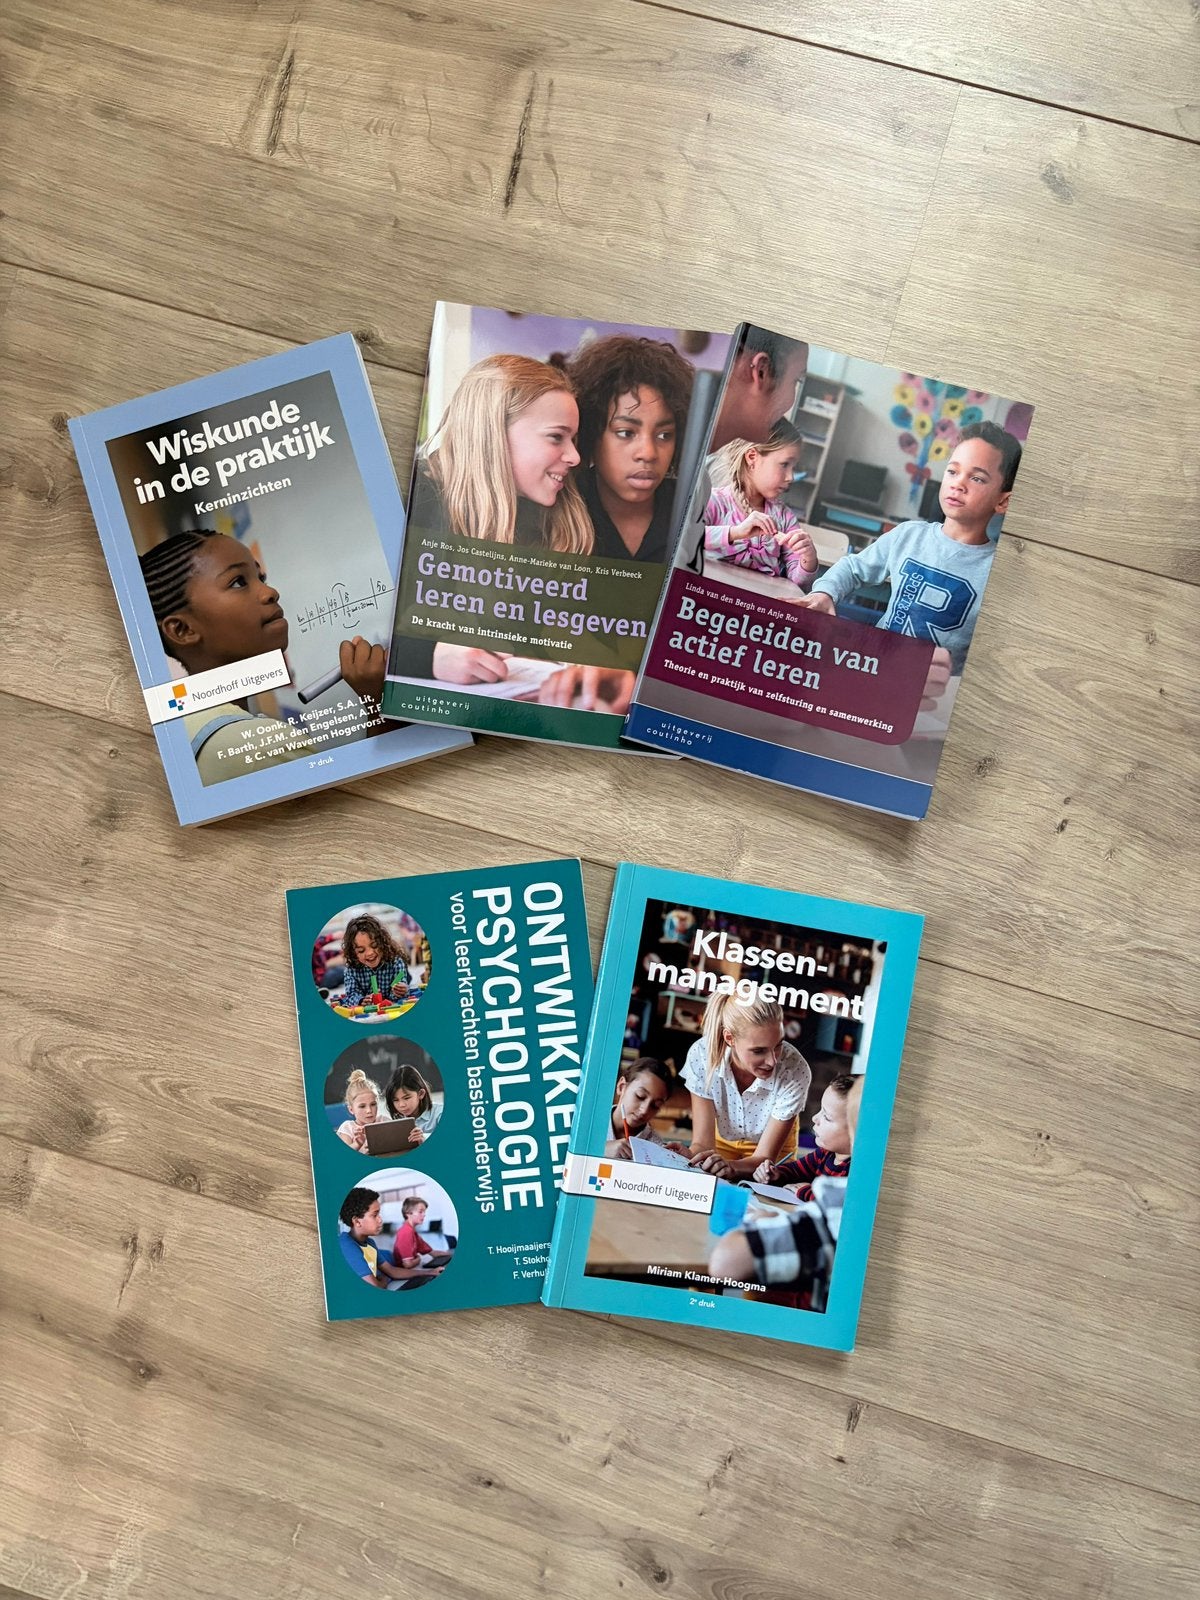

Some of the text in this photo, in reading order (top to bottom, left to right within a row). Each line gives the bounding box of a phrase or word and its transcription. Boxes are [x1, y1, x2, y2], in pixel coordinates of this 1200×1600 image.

[146, 400, 301, 465] Wiskunde
[134, 420, 335, 504] in de praktijk
[194, 477, 292, 515] Kerninzichten
[418, 552, 588, 601] Gemotiveerd
[421, 538, 642, 579] Anje Ros, Jos Castelijns, Anne-Marieke van Loon, Kris Verbeeck
[415, 580, 485, 615] leren
[493, 601, 525, 622] en
[533, 601, 647, 638] lesgeven
[685, 582, 799, 623] Linda van den Bergh en Anje Ros
[411, 616, 573, 650] De kracht van intrinsieke motivatie
[677, 596, 879, 675] Begeleiden van
[668, 630, 821, 690] actief leren
[192, 668, 284, 702] Noordhoff Uitgevers
[415, 696, 470, 710] uitgeverij
[664, 659, 894, 733] Theorie en praktijk van zelfsturing en samenwerking
[241, 694, 375, 740] W. Oonk, R. Keijzer, S.A. Lit,
[401, 702, 450, 715] coutinho
[217, 751, 227, 760] F.
[228, 741, 258, 757] Barth,
[259, 734, 288, 748] J.F.M.
[289, 726, 309, 739] den
[309, 714, 358, 732] Engelsen,
[245, 717, 386, 764] & C. van Waveren Hogervorst
[646, 727, 693, 746] coutinho
[661, 722, 713, 743] uitgeverij
[318, 756, 334, 767] druk
[692, 929, 828, 977] Klassen-
[647, 961, 865, 1020] management
[449, 892, 499, 1213] voor leerkrachten basisonderwijs
[472, 886, 544, 1211] PSYCHOLOGIE
[523, 882, 582, 1188] ONTWIKKEL
[613, 1179, 708, 1203] Noordhoff Uitgevers
[487, 1241, 551, 1255] T. Hooijmaaijers
[514, 1255, 550, 1266] T. Stokho
[513, 1271, 520, 1279] F.
[647, 1265, 766, 1292] Miriam Klamer-Hoogma
[698, 1298, 715, 1308] druk
